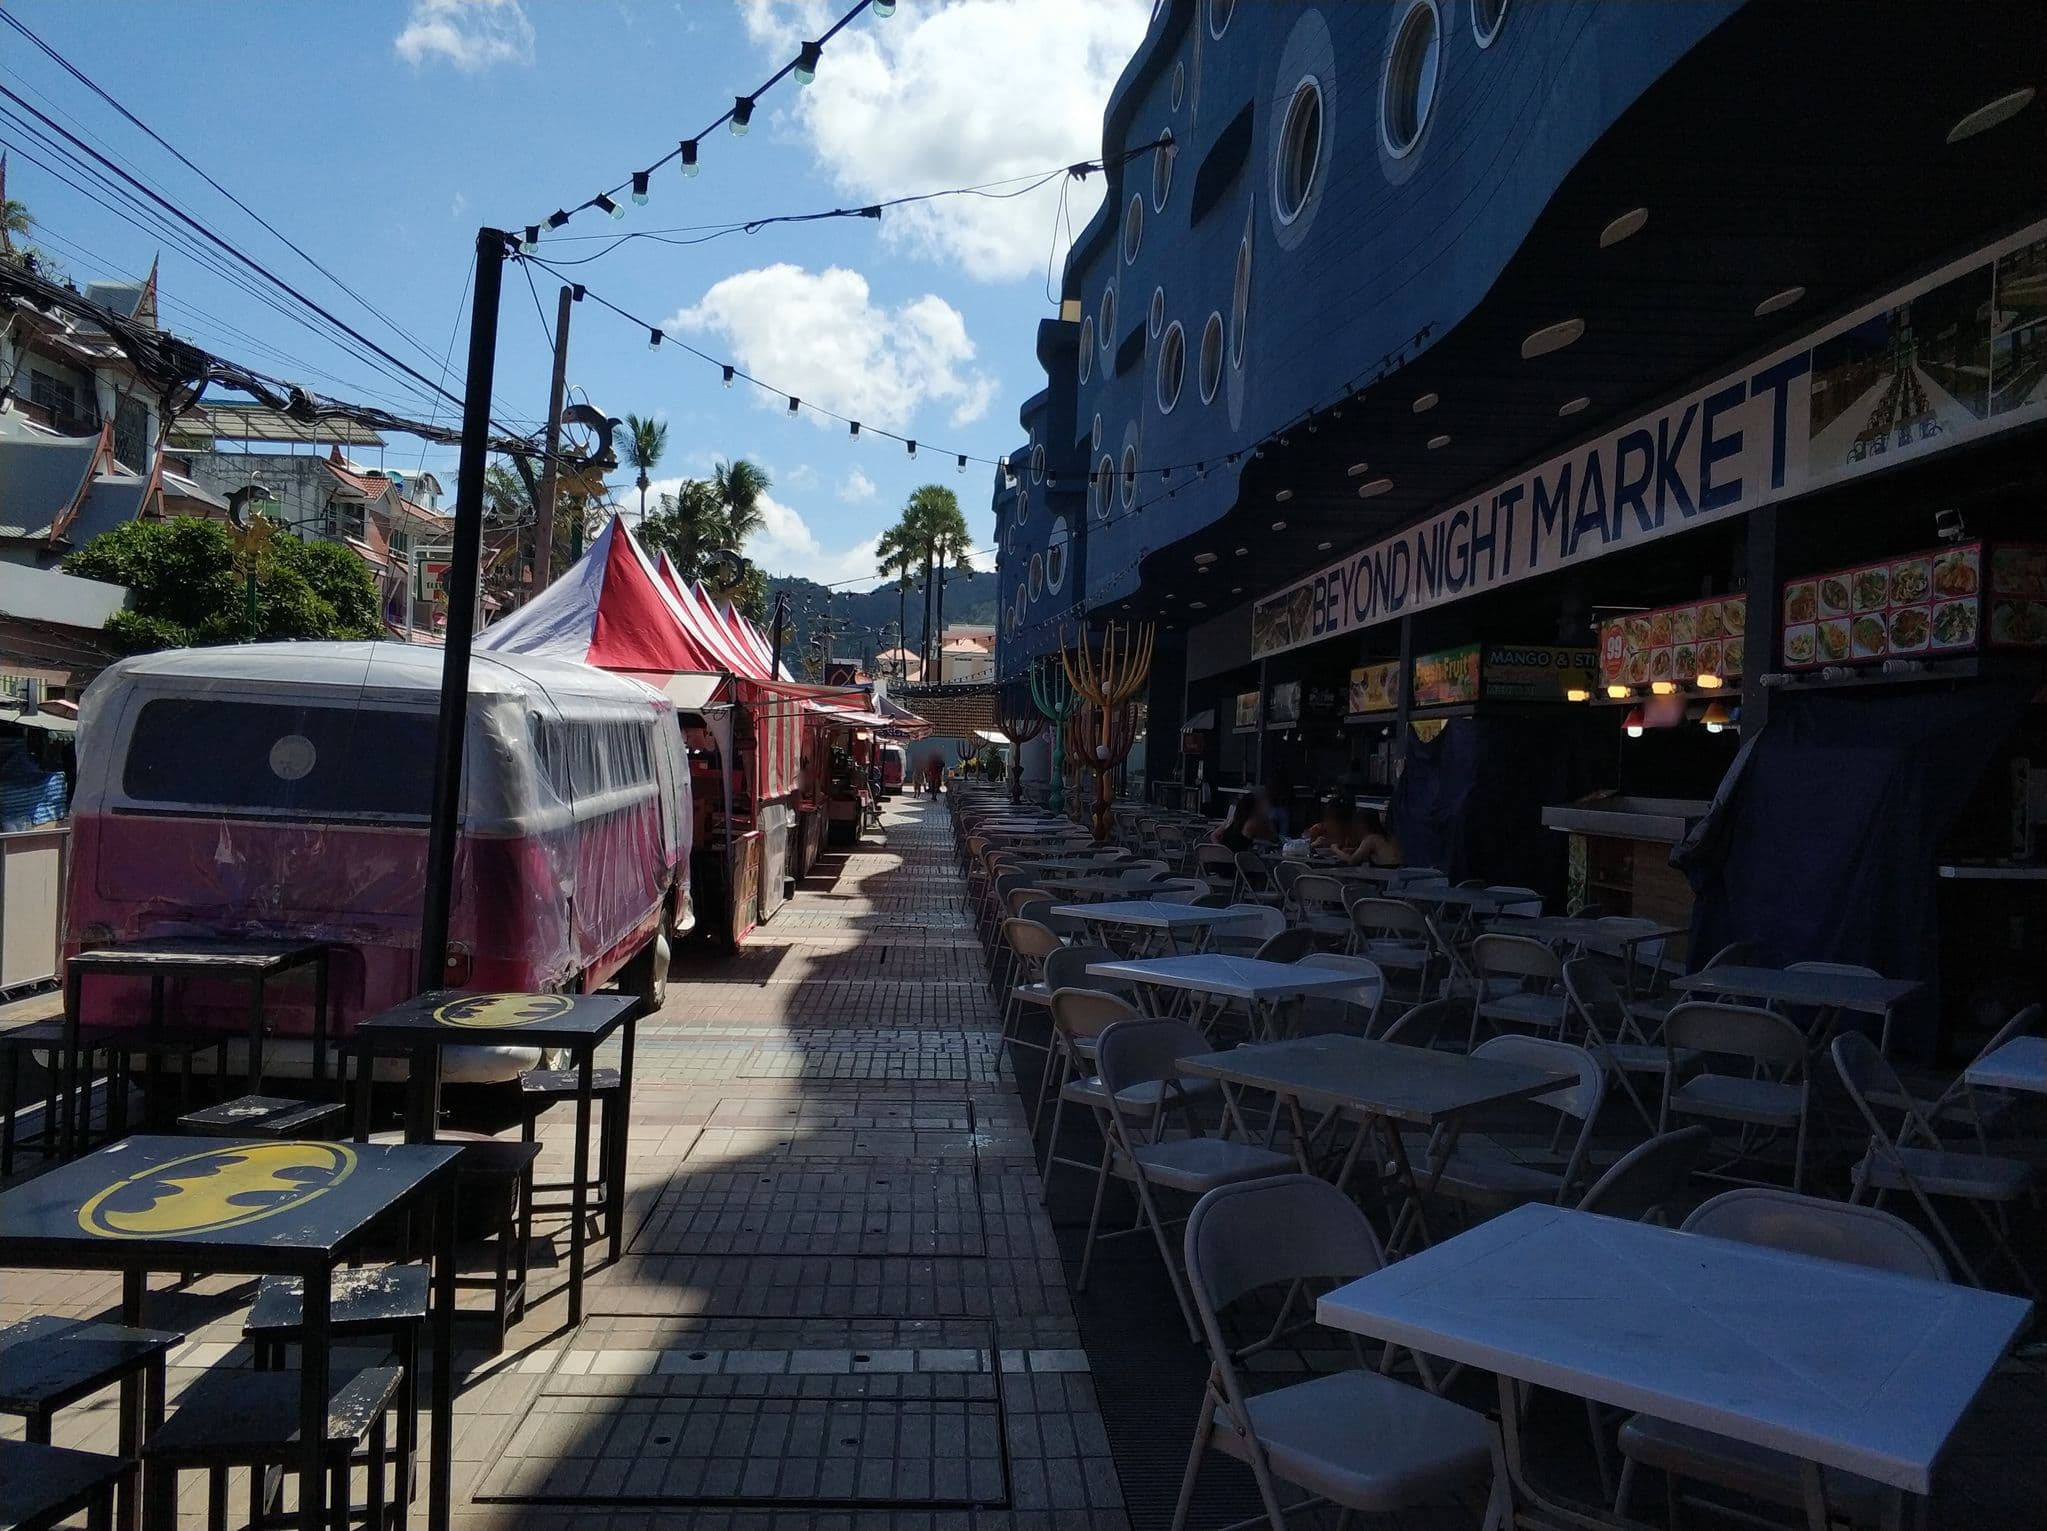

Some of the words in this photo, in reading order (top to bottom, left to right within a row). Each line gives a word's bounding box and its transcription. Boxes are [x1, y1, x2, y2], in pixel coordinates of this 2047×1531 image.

[1312, 540, 1410, 636] BEYOND
[1416, 484, 1524, 605] NIGHT
[1530, 349, 1811, 568] MARKET
[1489, 651, 1551, 666] MANGO
[1556, 653, 1569, 667] &
[1607, 636, 1622, 660] 99
